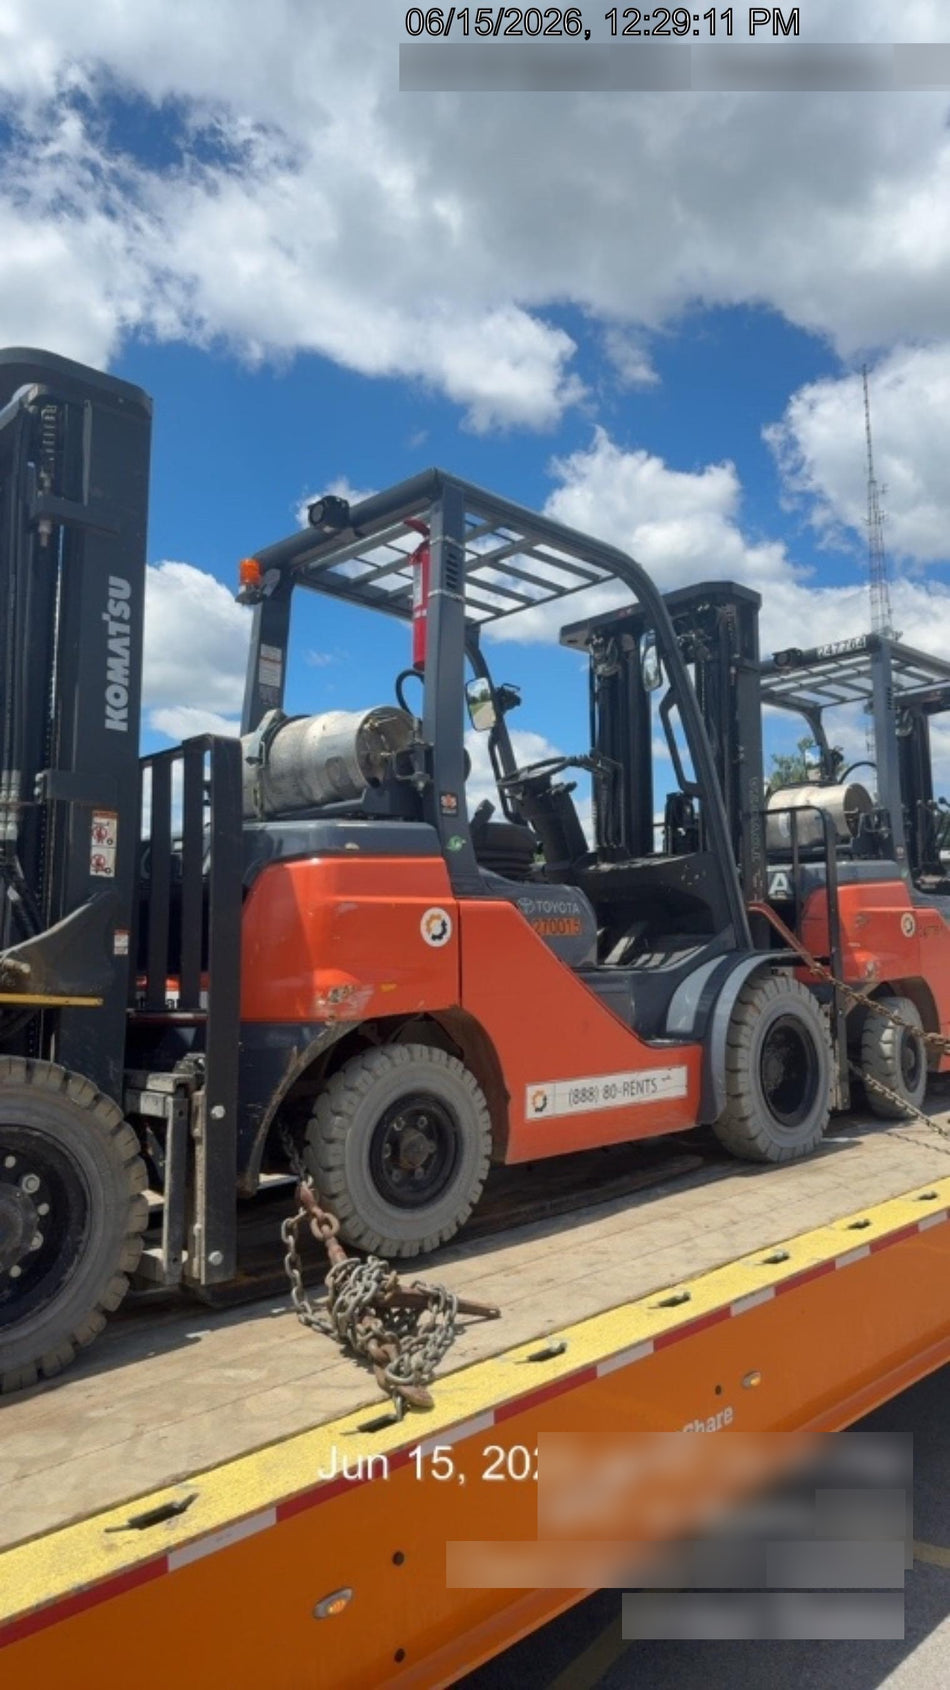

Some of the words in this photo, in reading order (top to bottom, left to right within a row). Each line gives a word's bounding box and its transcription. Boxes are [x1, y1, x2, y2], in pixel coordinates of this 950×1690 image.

[102, 575, 132, 732] KOMATSU
[535, 900, 580, 914] TOYOTA
[568, 1086, 599, 1107] (888)
[602, 1077, 658, 1100] 80-RENTS
